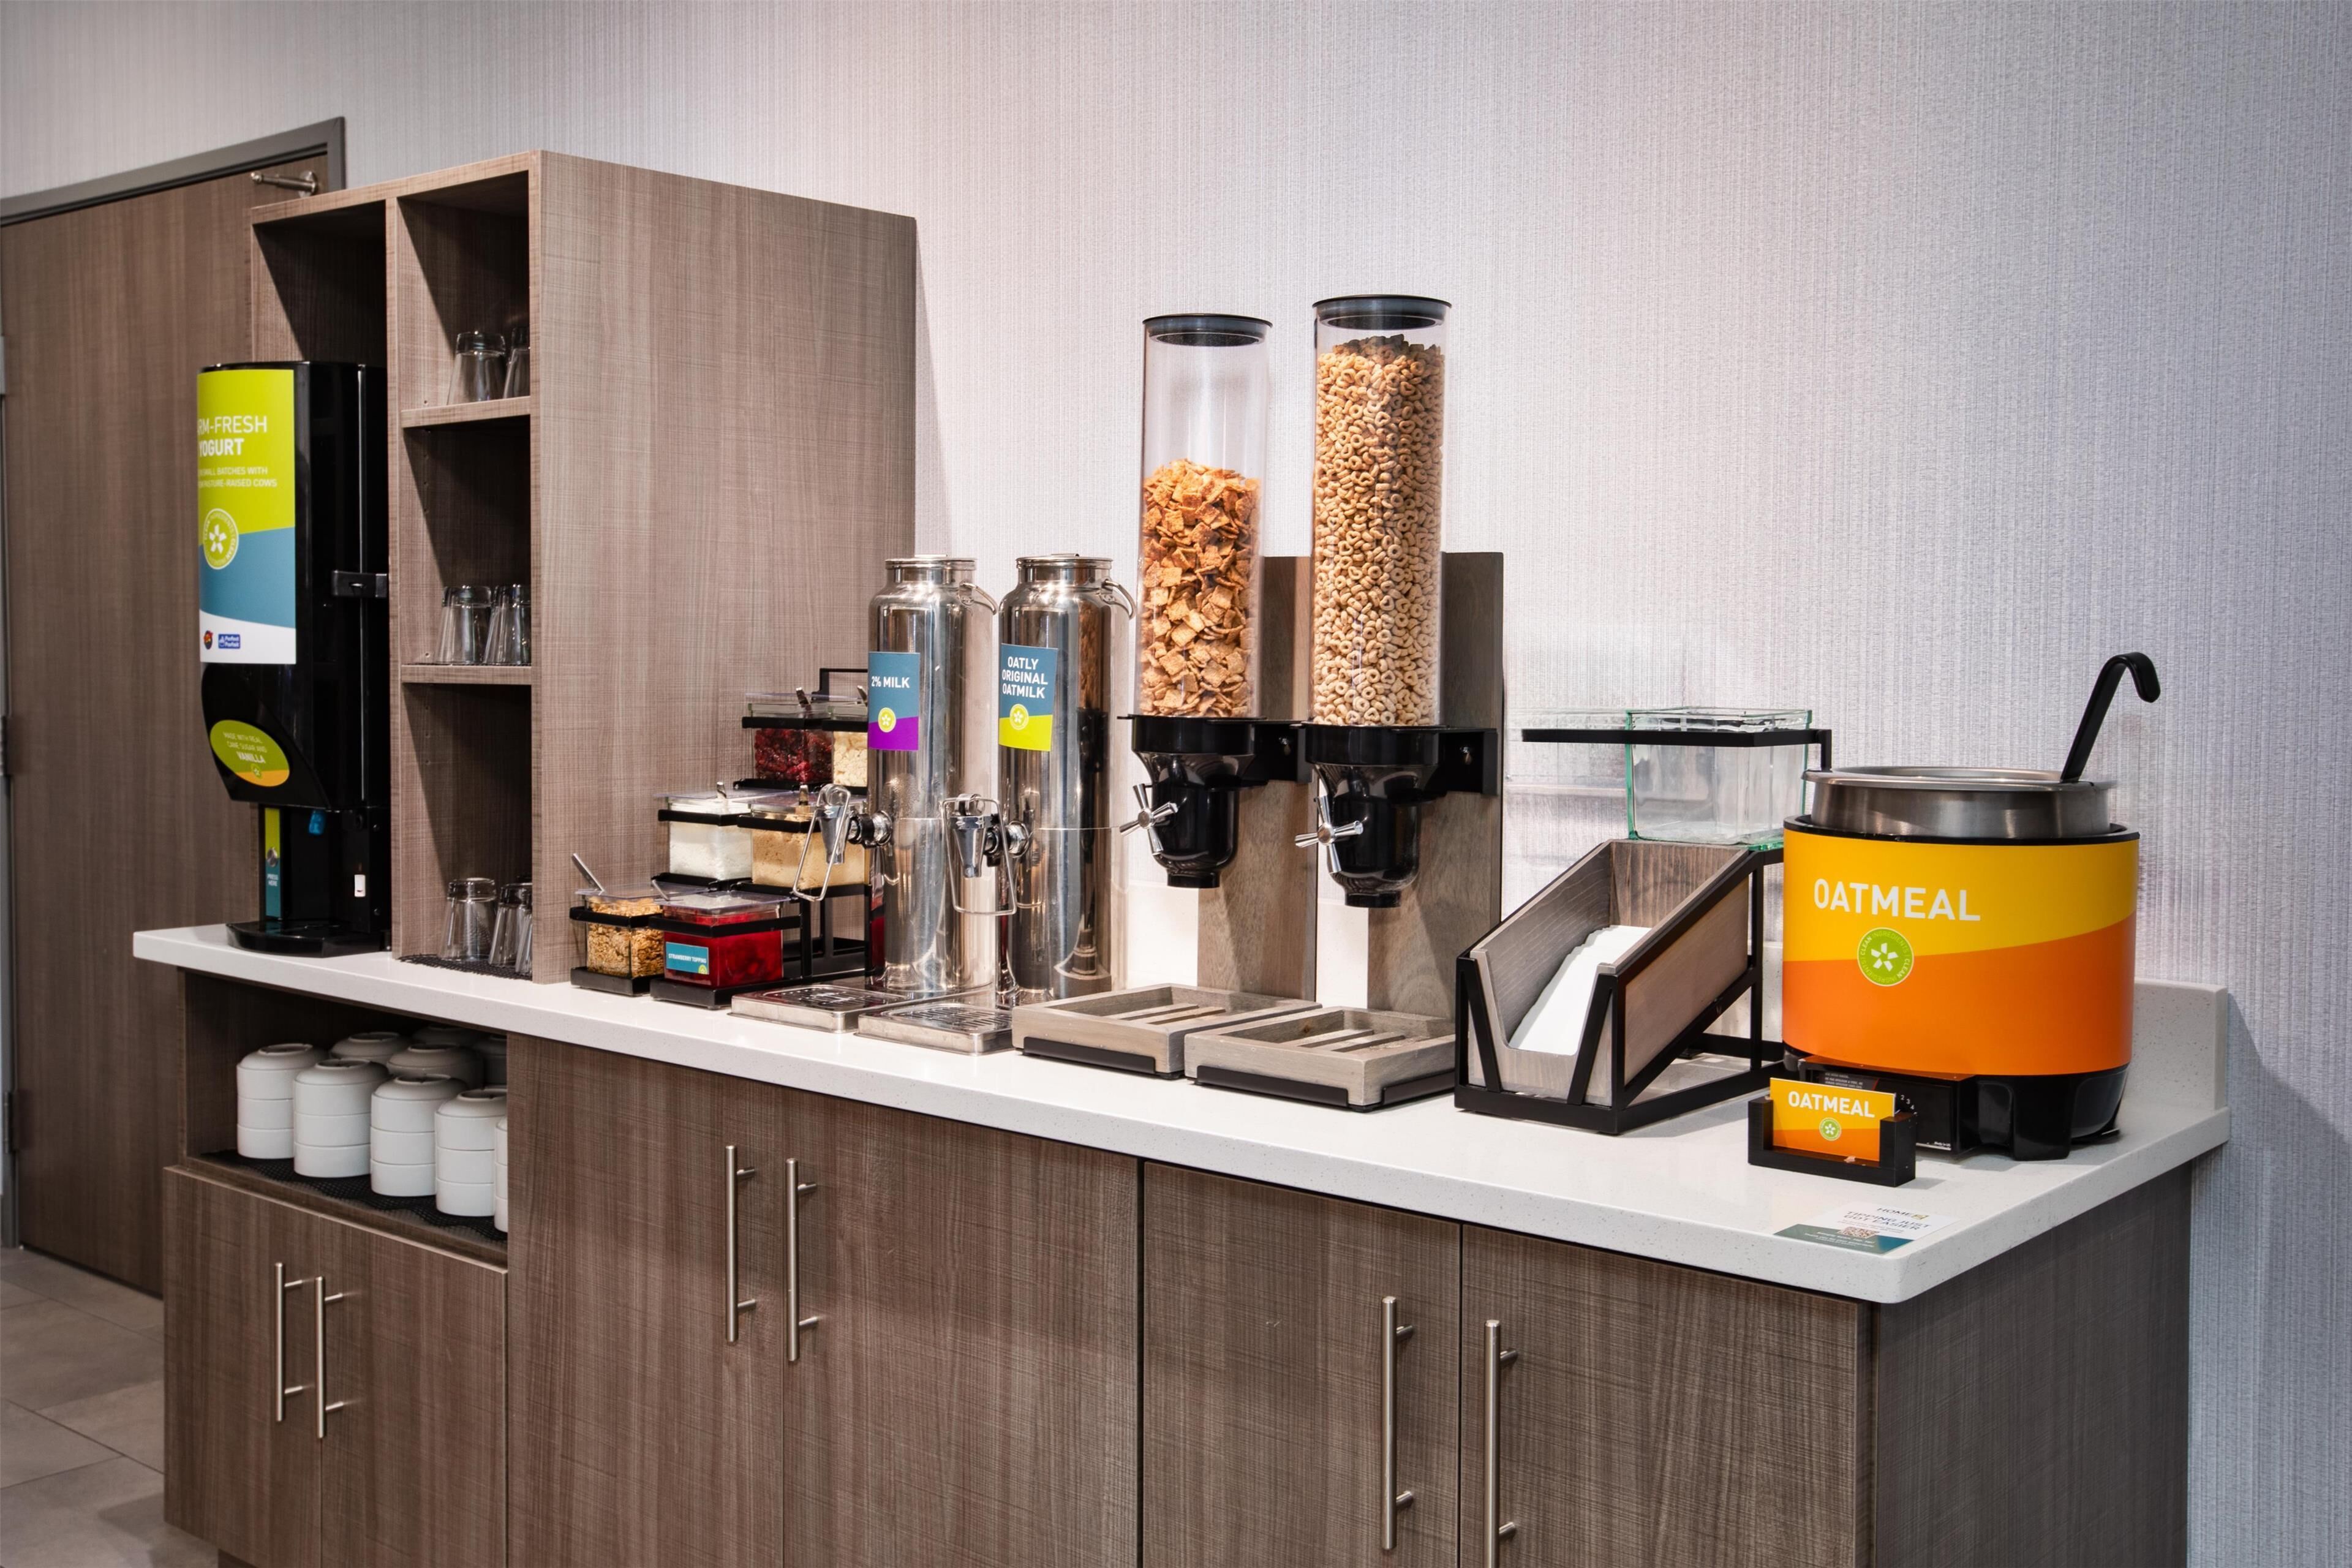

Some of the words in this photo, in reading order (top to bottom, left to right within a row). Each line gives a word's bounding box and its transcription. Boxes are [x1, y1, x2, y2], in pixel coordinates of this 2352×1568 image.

[199, 438, 244, 458] YOGURT
[217, 467, 246, 475] BATCHES
[253, 478, 277, 488] COWS
[1008, 656, 1039, 670] OATLY
[871, 676, 881, 687] 2%
[883, 676, 910, 688] MILK
[1002, 669, 1048, 685] ORIGINAL
[1002, 683, 1045, 699] OATMILK
[236, 751, 266, 764] VANILLA
[1814, 878, 1981, 922] OATMEAL
[668, 953, 692, 962] STRAWBERRY
[1860, 937, 1872, 956] CLEAN
[1872, 930, 1909, 953] INGREDIENTS
[1896, 959, 1910, 979] CLEAN
[1788, 1090, 1875, 1118] OATMEAL
[1847, 1211, 1898, 1222] TIPPING
[1872, 1219, 1921, 1230] EASIER
